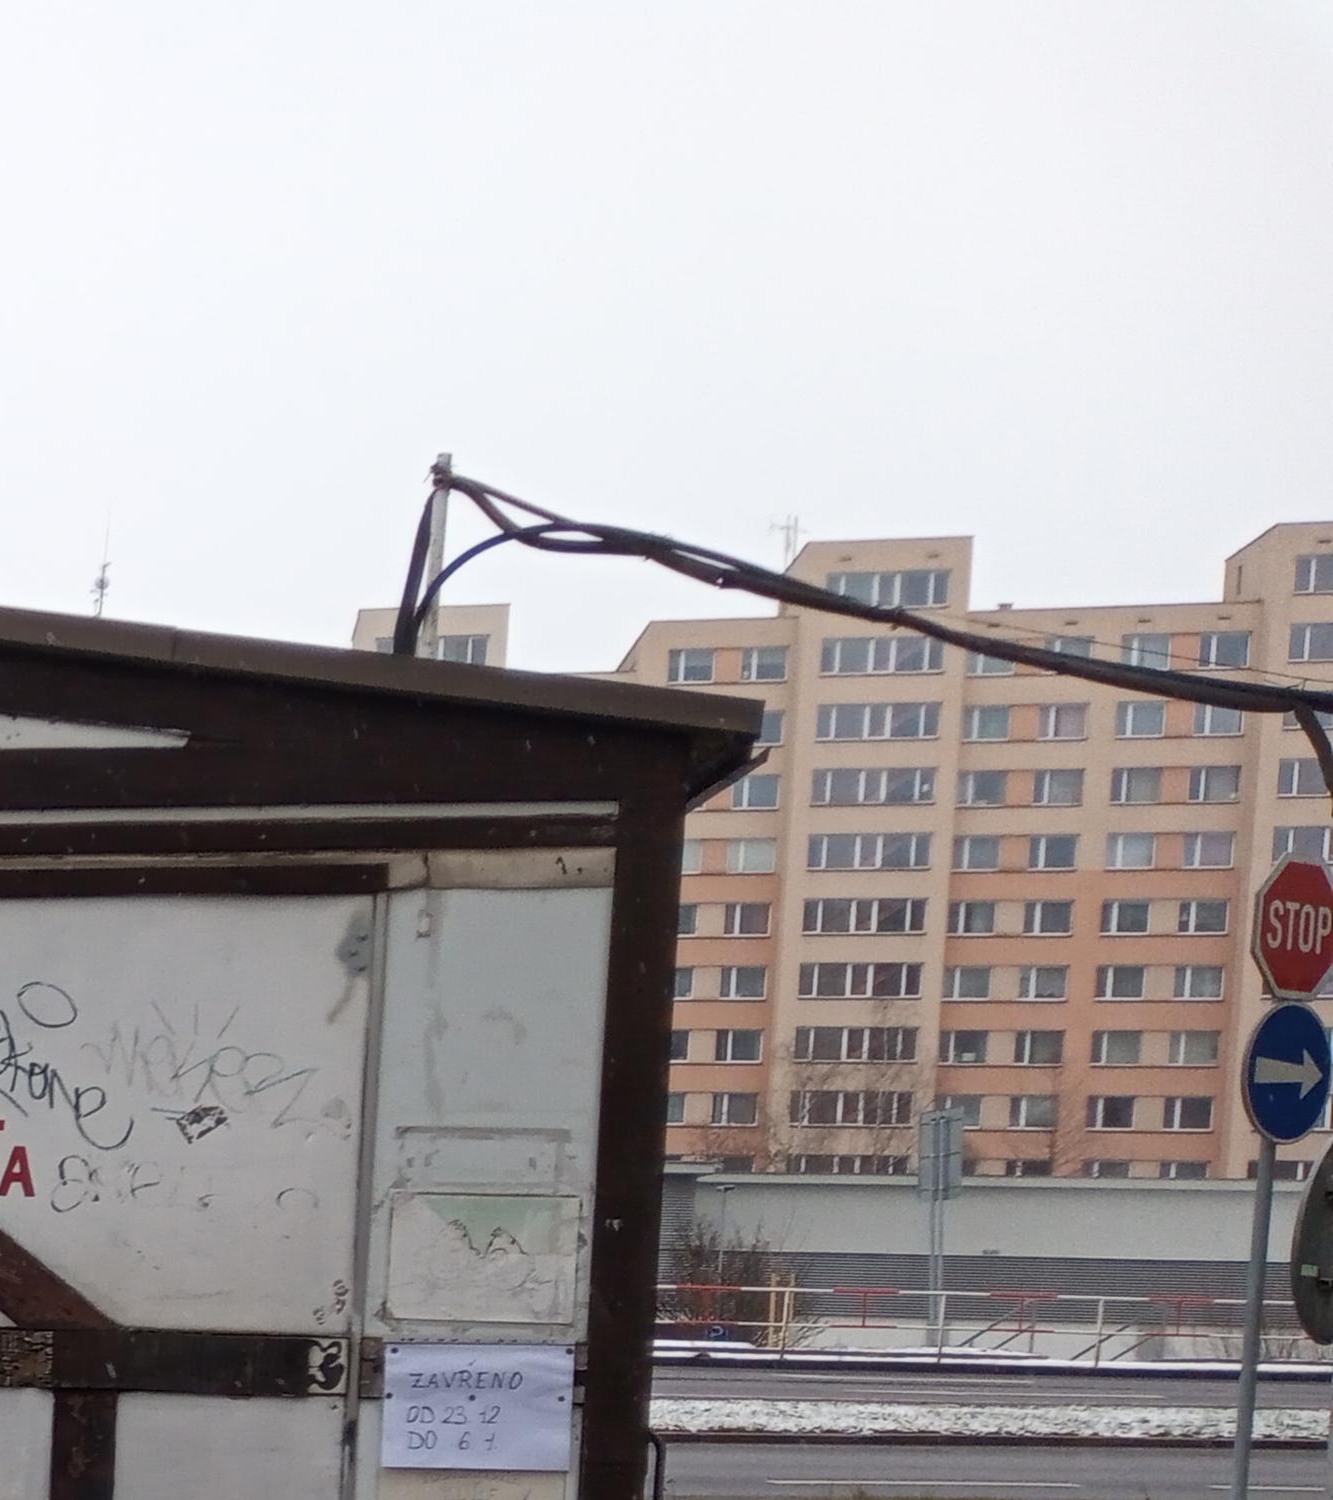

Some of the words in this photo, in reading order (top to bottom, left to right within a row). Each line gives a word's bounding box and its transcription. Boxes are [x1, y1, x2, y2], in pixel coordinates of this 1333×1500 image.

[1266, 899, 1333, 955] STOP
[407, 1405, 435, 1424] OD
[442, 1405, 468, 1424] 23
[408, 1430, 437, 1450] DO
[458, 1431, 471, 1450] 6
